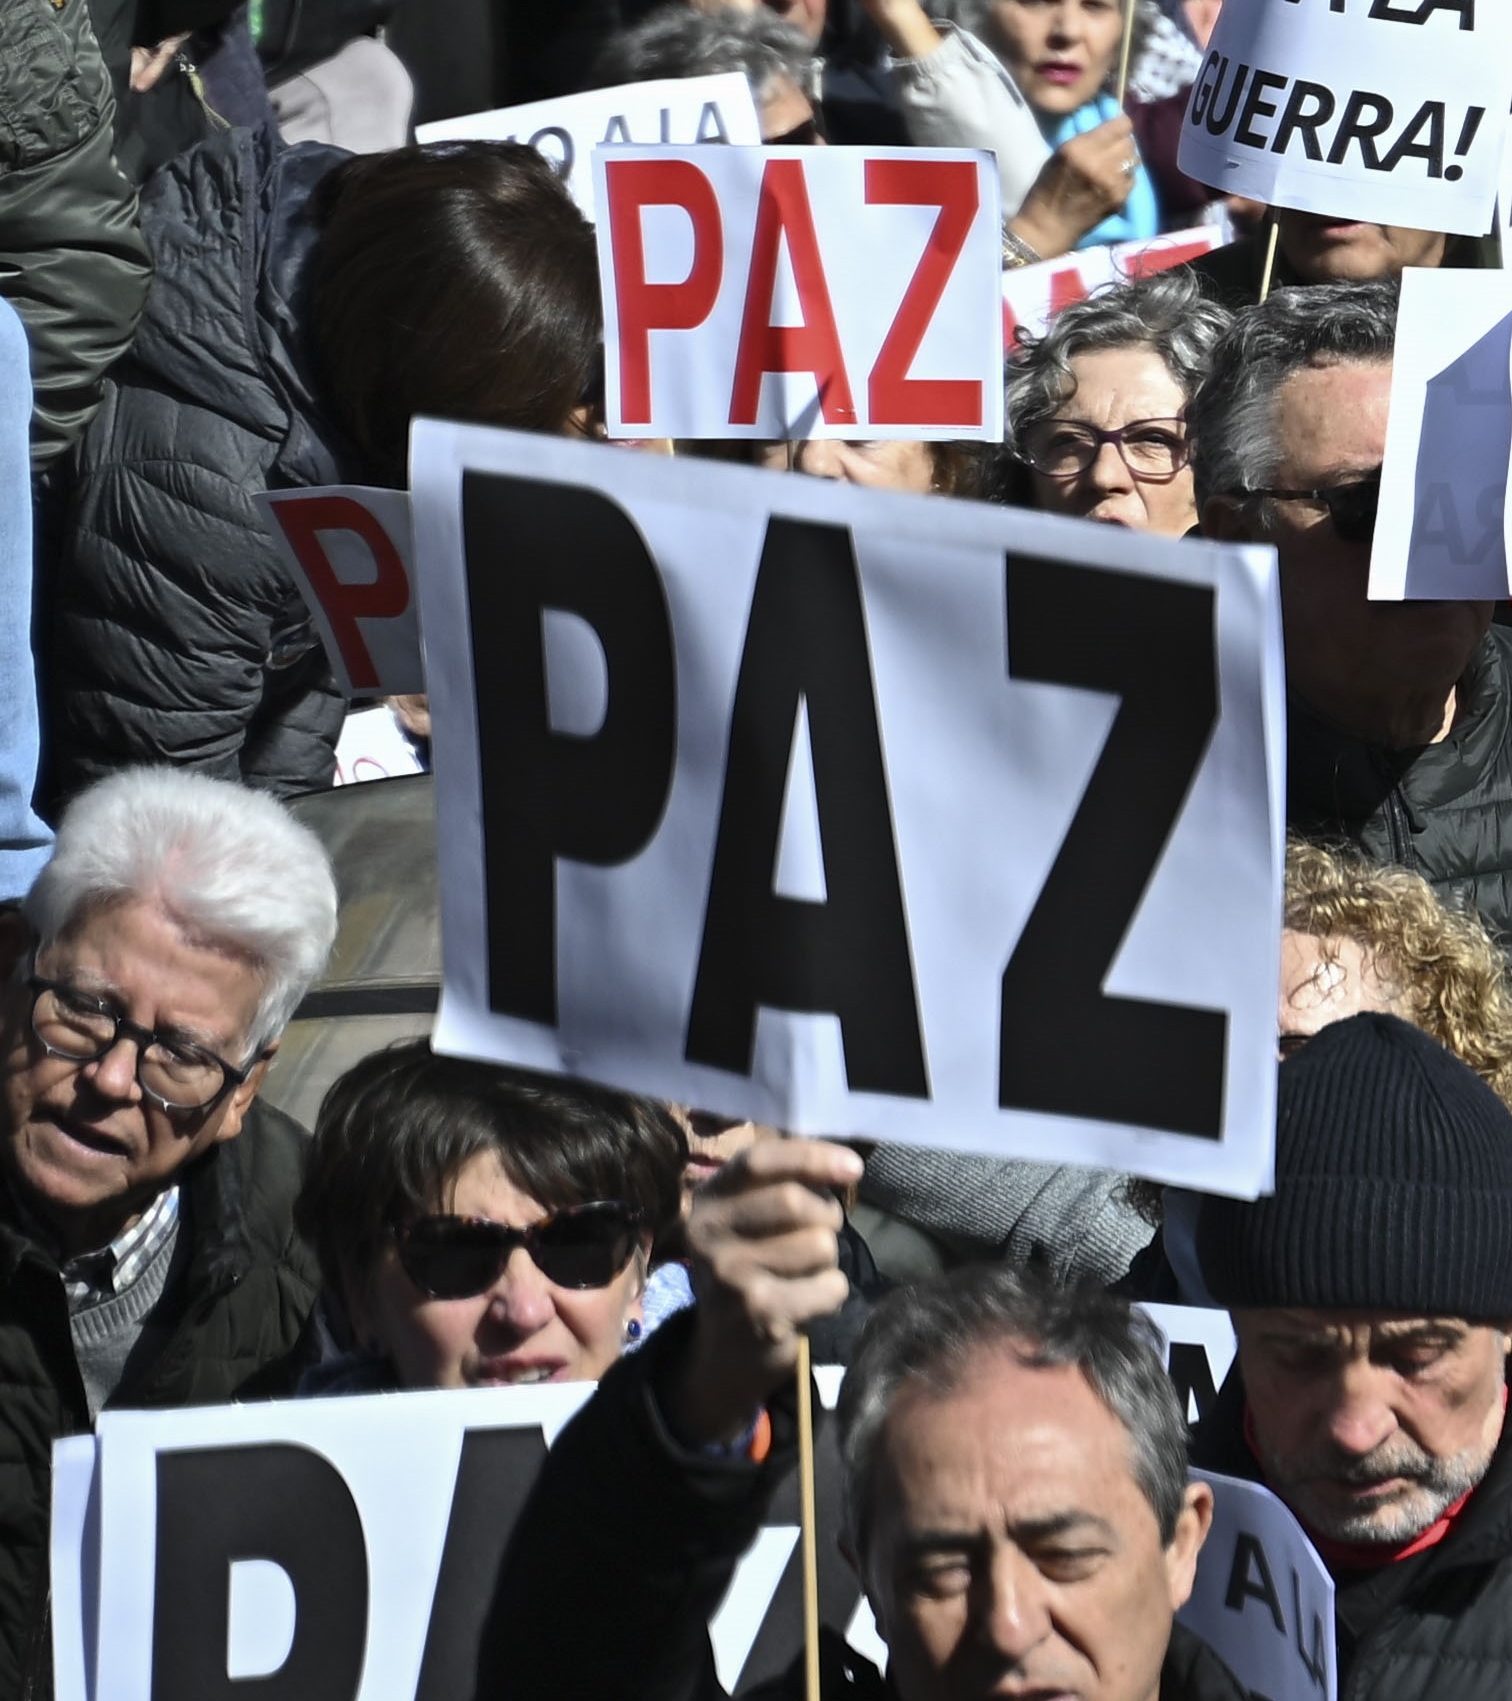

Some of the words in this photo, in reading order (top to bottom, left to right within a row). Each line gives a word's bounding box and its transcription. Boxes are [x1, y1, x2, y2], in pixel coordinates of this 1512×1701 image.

[1189, 49, 1485, 183] GUERRA!
[605, 158, 984, 427] PAZ
[461, 469, 1229, 1142] PAZ
[1224, 1529, 1288, 1638] A
